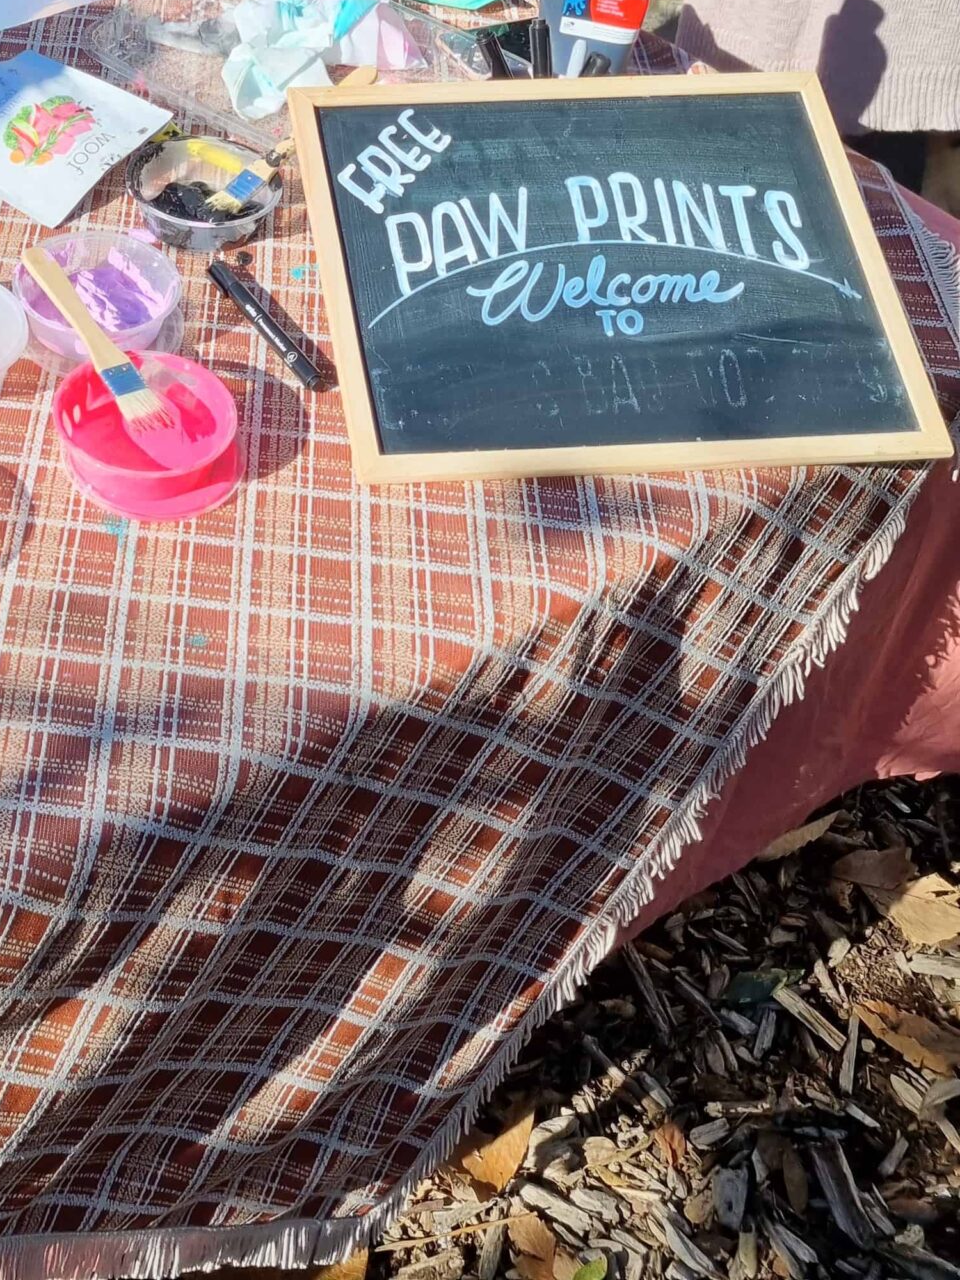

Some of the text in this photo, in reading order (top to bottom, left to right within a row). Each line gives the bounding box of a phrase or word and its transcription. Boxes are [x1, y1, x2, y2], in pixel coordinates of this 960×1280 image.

[337, 108, 452, 215] FREE
[384, 170, 812, 298] PAW PRINTS
[466, 254, 746, 328] Welcome
[595, 308, 646, 338] TO
